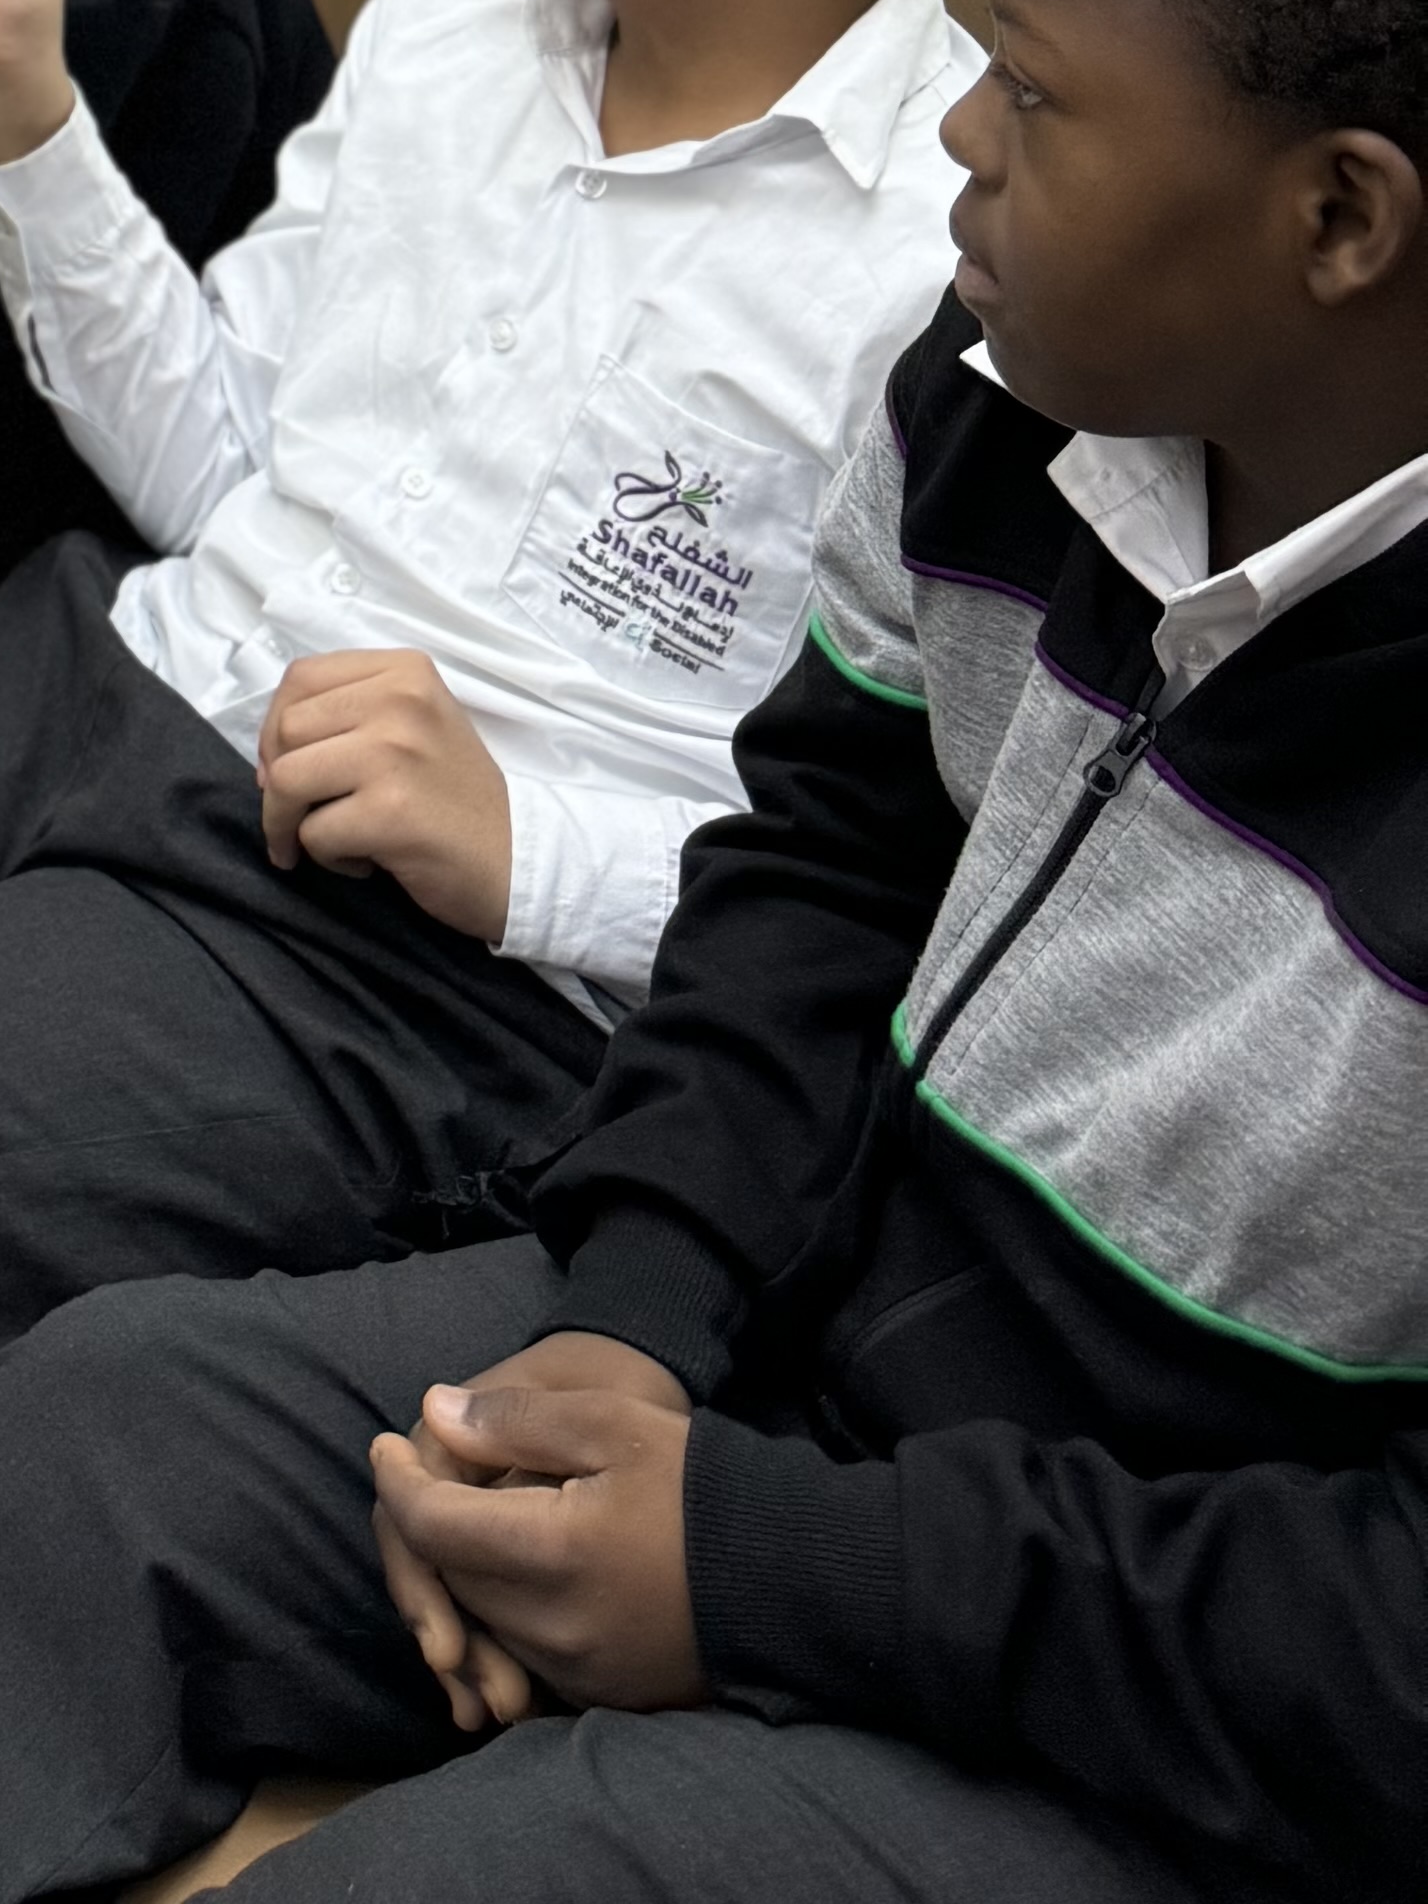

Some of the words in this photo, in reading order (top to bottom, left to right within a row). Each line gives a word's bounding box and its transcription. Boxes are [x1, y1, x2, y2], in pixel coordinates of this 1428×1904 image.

[592, 518, 739, 617] Shafallah
[646, 525, 753, 589] الشفلح
[568, 558, 631, 605] Integration
[631, 595, 650, 613] for
[650, 606, 671, 628] the
[669, 619, 726, 657] Disabled
[648, 637, 701, 674] Social
